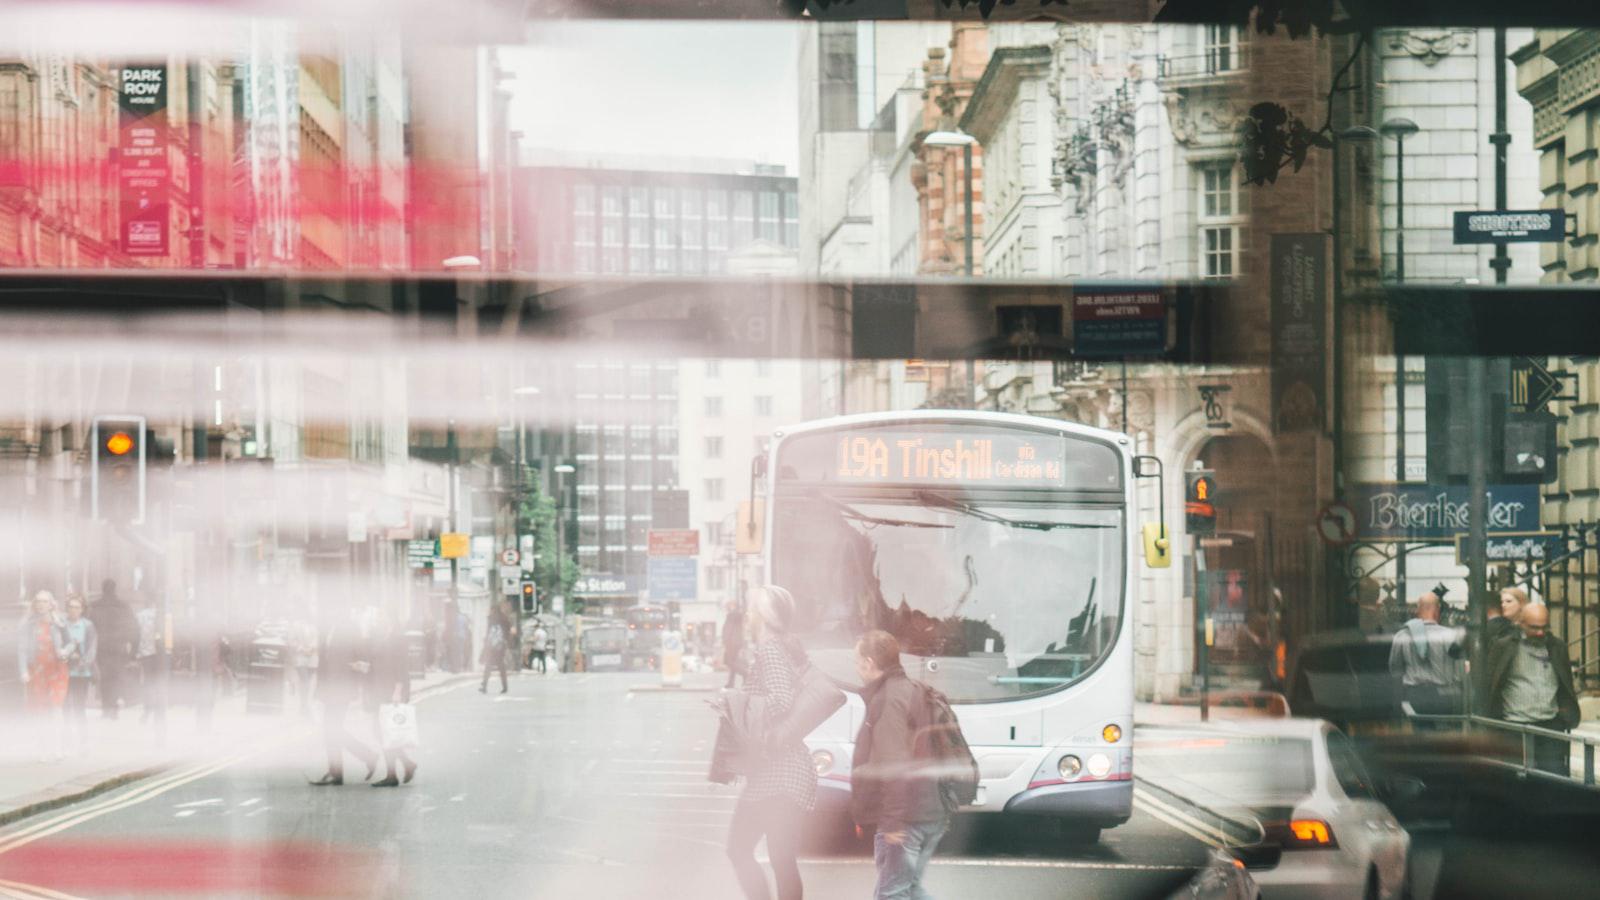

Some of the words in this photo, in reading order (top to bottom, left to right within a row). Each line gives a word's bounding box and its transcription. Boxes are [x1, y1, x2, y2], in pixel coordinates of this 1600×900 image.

[122, 69, 162, 81] PARK
[124, 82, 160, 95] ROW
[1469, 213, 1551, 232] SHOOTERS
[839, 436, 889, 477] 19A
[896, 438, 992, 480] Tinshill
[1369, 491, 1524, 530] Bierkeler
